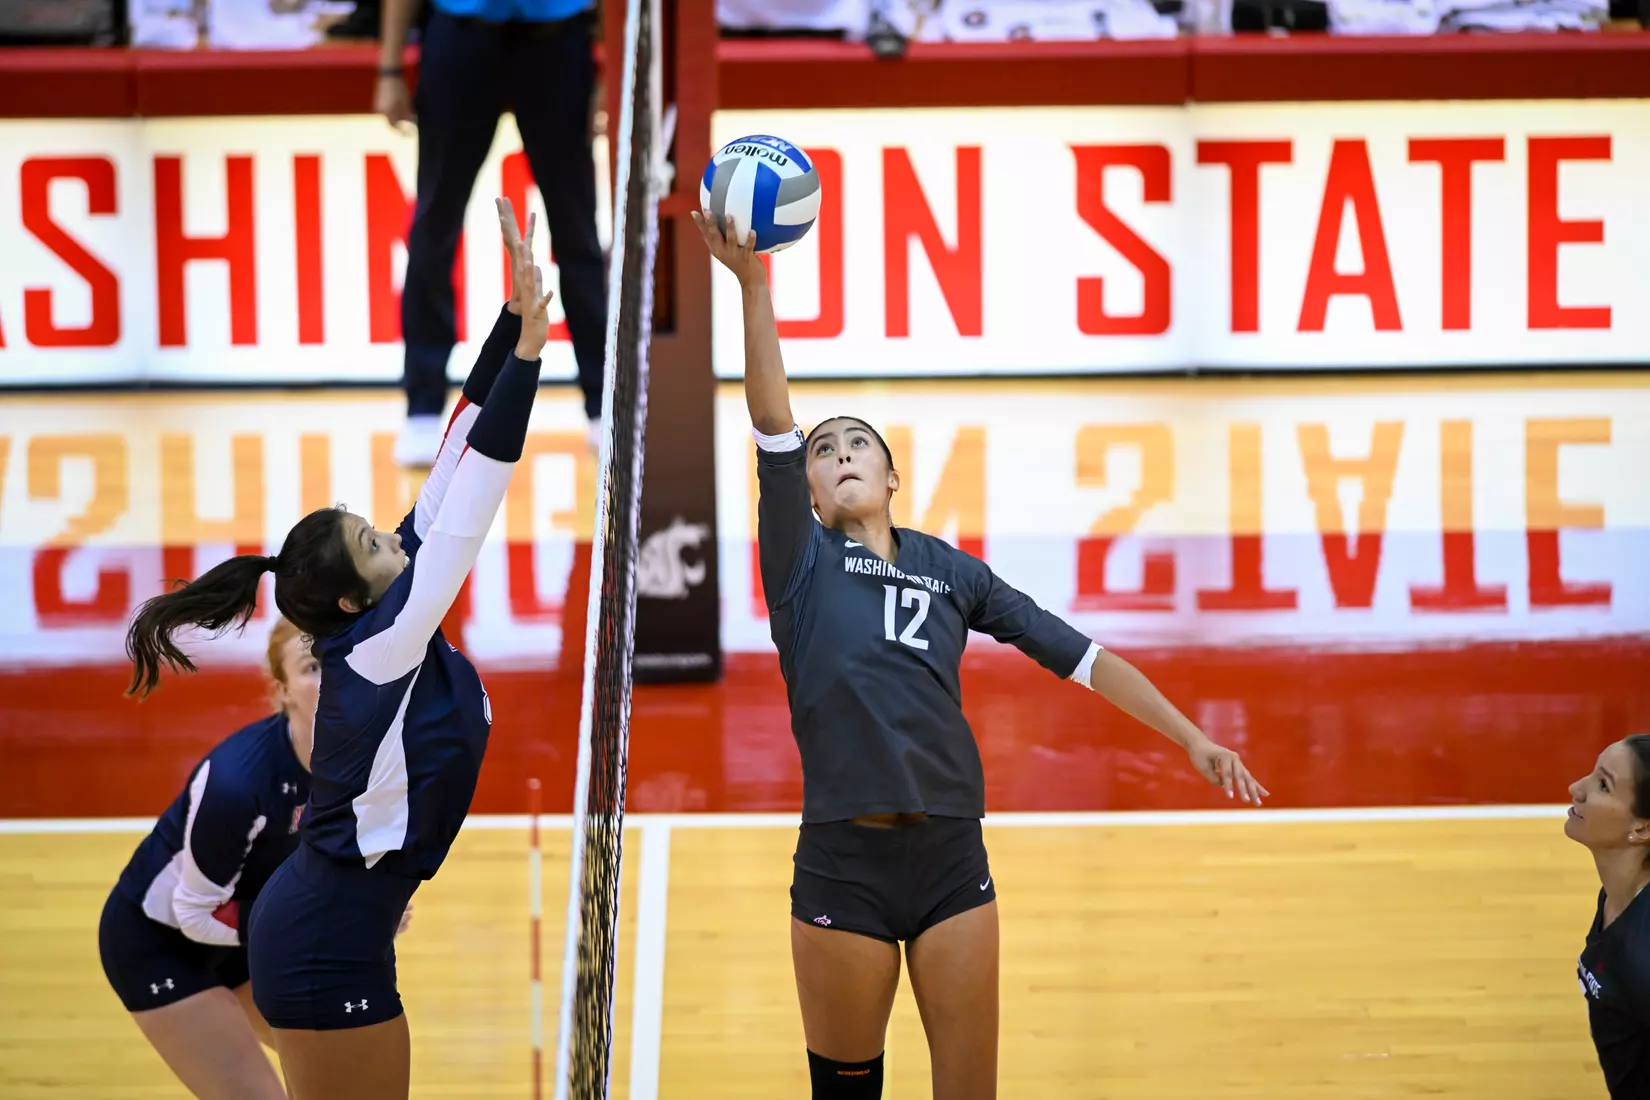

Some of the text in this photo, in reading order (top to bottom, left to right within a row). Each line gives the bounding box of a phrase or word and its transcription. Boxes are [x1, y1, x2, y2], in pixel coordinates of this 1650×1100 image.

[724, 144, 788, 167] molten
[1068, 134, 1612, 336] STATE
[844, 556, 924, 585] WASHING
[882, 584, 931, 650] 12
